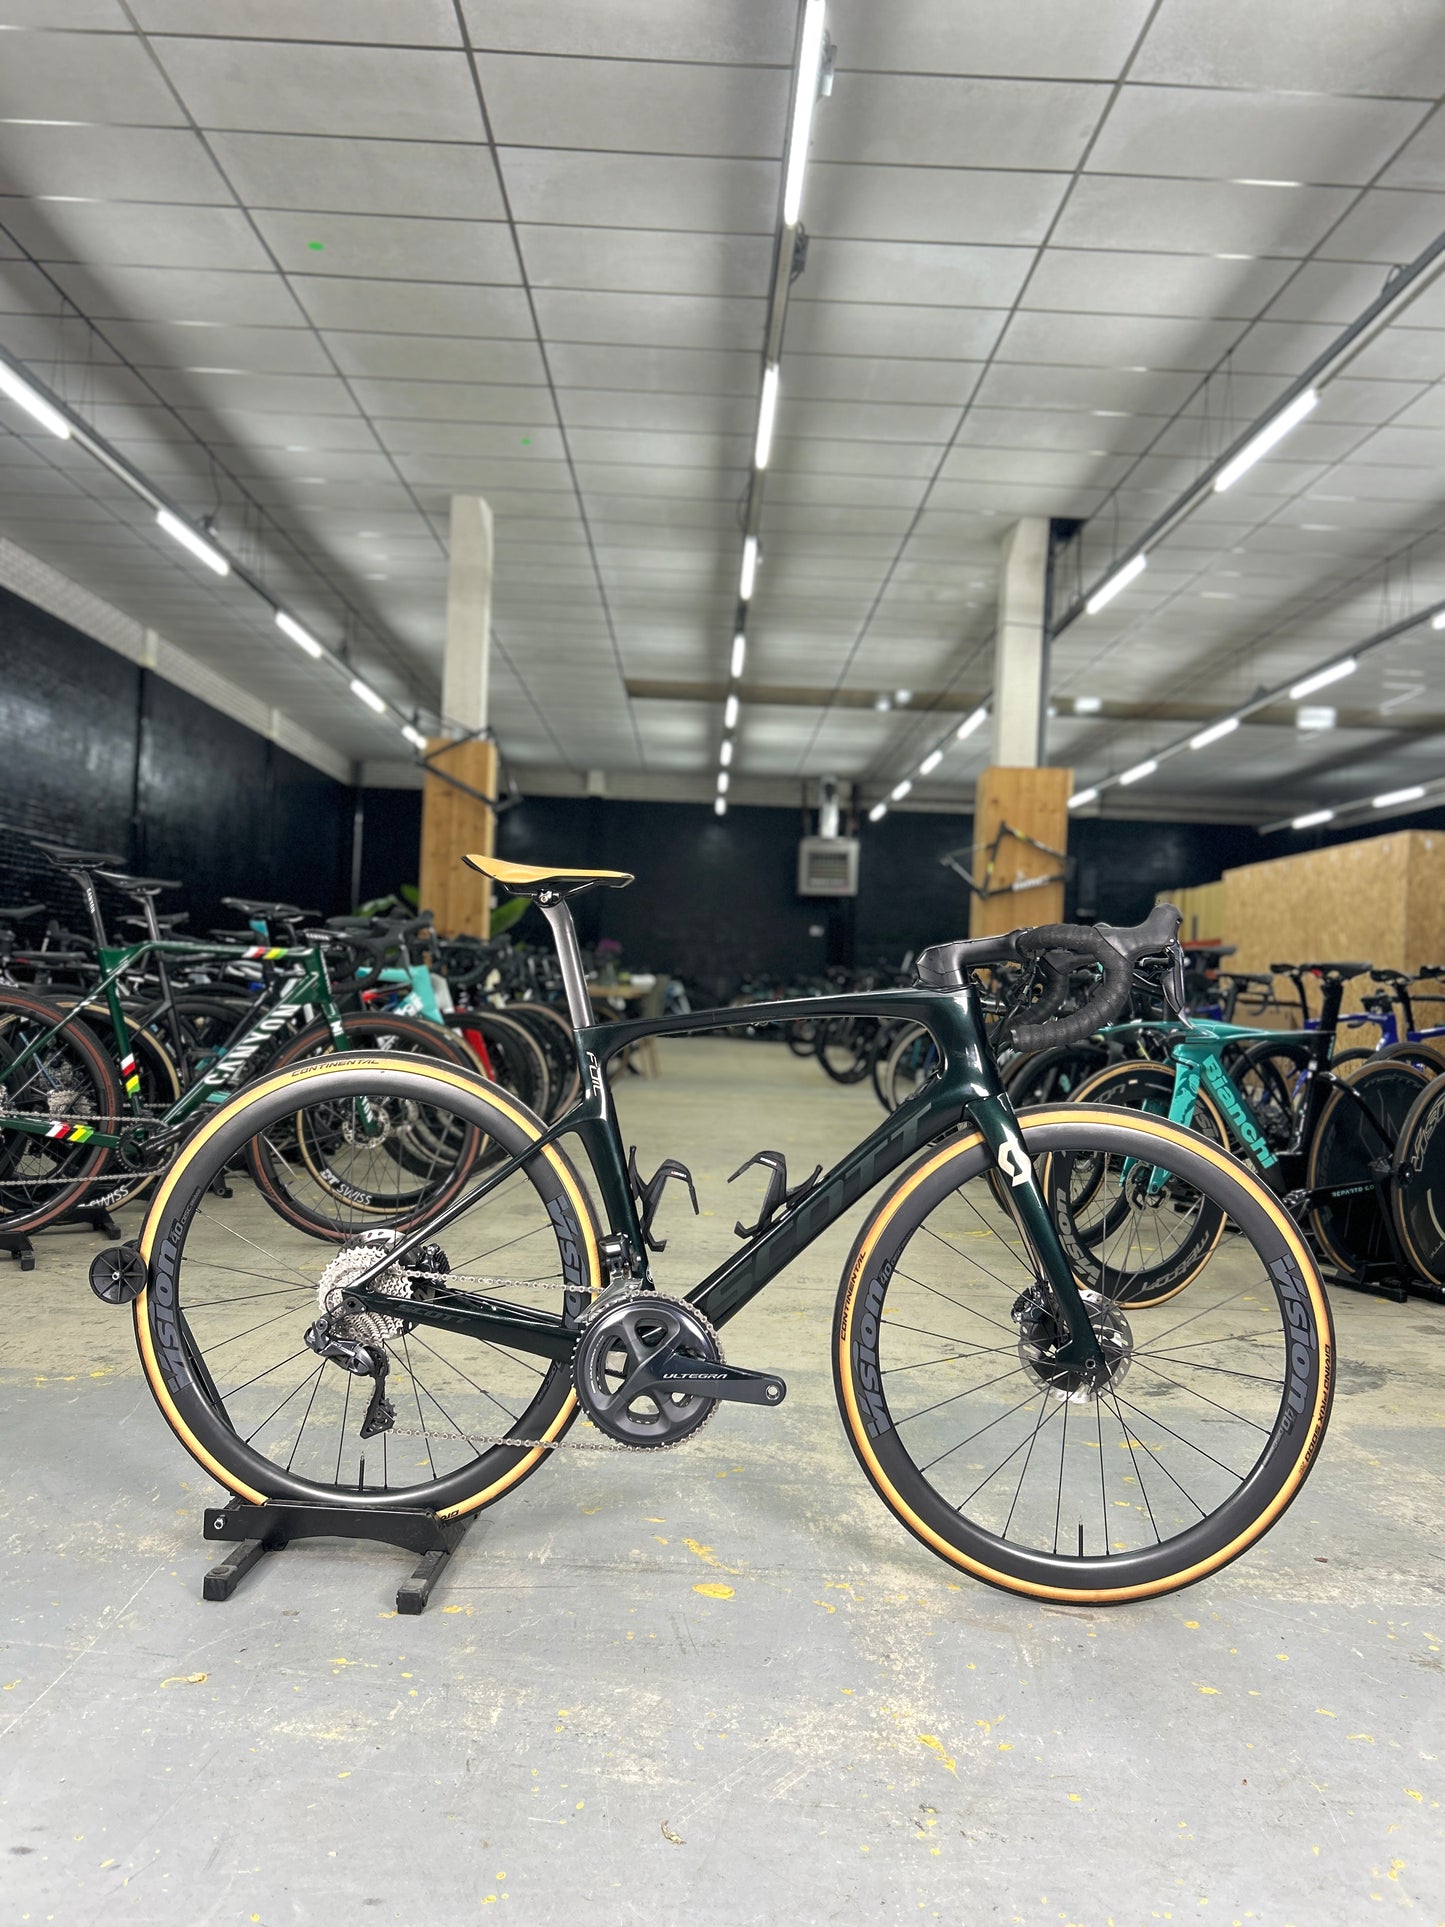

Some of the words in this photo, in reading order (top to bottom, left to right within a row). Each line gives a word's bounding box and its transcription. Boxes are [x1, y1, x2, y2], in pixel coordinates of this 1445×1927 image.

[204, 1003, 302, 1086] CANYON
[291, 1058, 380, 1078] CONTINENTAL
[586, 1050, 605, 1097] FOIL
[1201, 1053, 1279, 1170] Bianchi
[336, 1184, 373, 1205] SWISS
[699, 1102, 932, 1313] SCOTT
[170, 1221, 184, 1244] 40
[881, 1262, 893, 1284] 40
[841, 1251, 866, 1341] CONTINENTAL
[395, 1304, 473, 1325] SCOTT
[662, 1372, 728, 1380] ULTEGRA
[1323, 1344, 1332, 1391] GRAND
[1281, 1409, 1295, 1431] 40
[1318, 1390, 1328, 1424] PRIX
[1304, 1424, 1321, 1462] 5000
